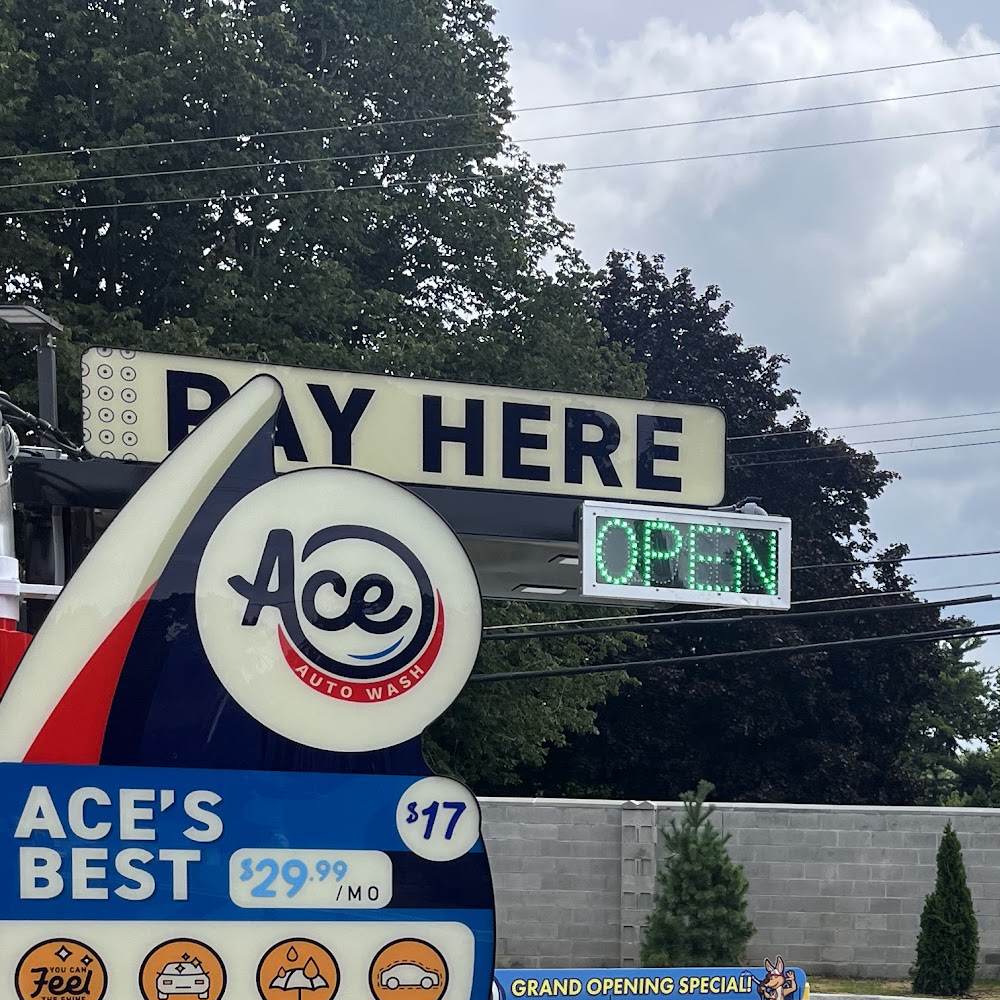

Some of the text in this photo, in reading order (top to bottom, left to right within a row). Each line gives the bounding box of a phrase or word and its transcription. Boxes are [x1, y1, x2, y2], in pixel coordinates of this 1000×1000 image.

[422, 394, 684, 493] HERE
[595, 517, 779, 596] OPEN
[228, 528, 411, 635] Ace
[297, 663, 424, 701] AUTO WASH
[14, 785, 224, 843] ACE'S
[405, 801, 467, 841] $17
[18, 847, 201, 901] BEST
[239, 857, 348, 898] $29.99
[30, 967, 93, 998] Feel
[49, 965, 87, 974] YOU CAN
[511, 975, 753, 998] GRAND OPENING SPECIAL!
